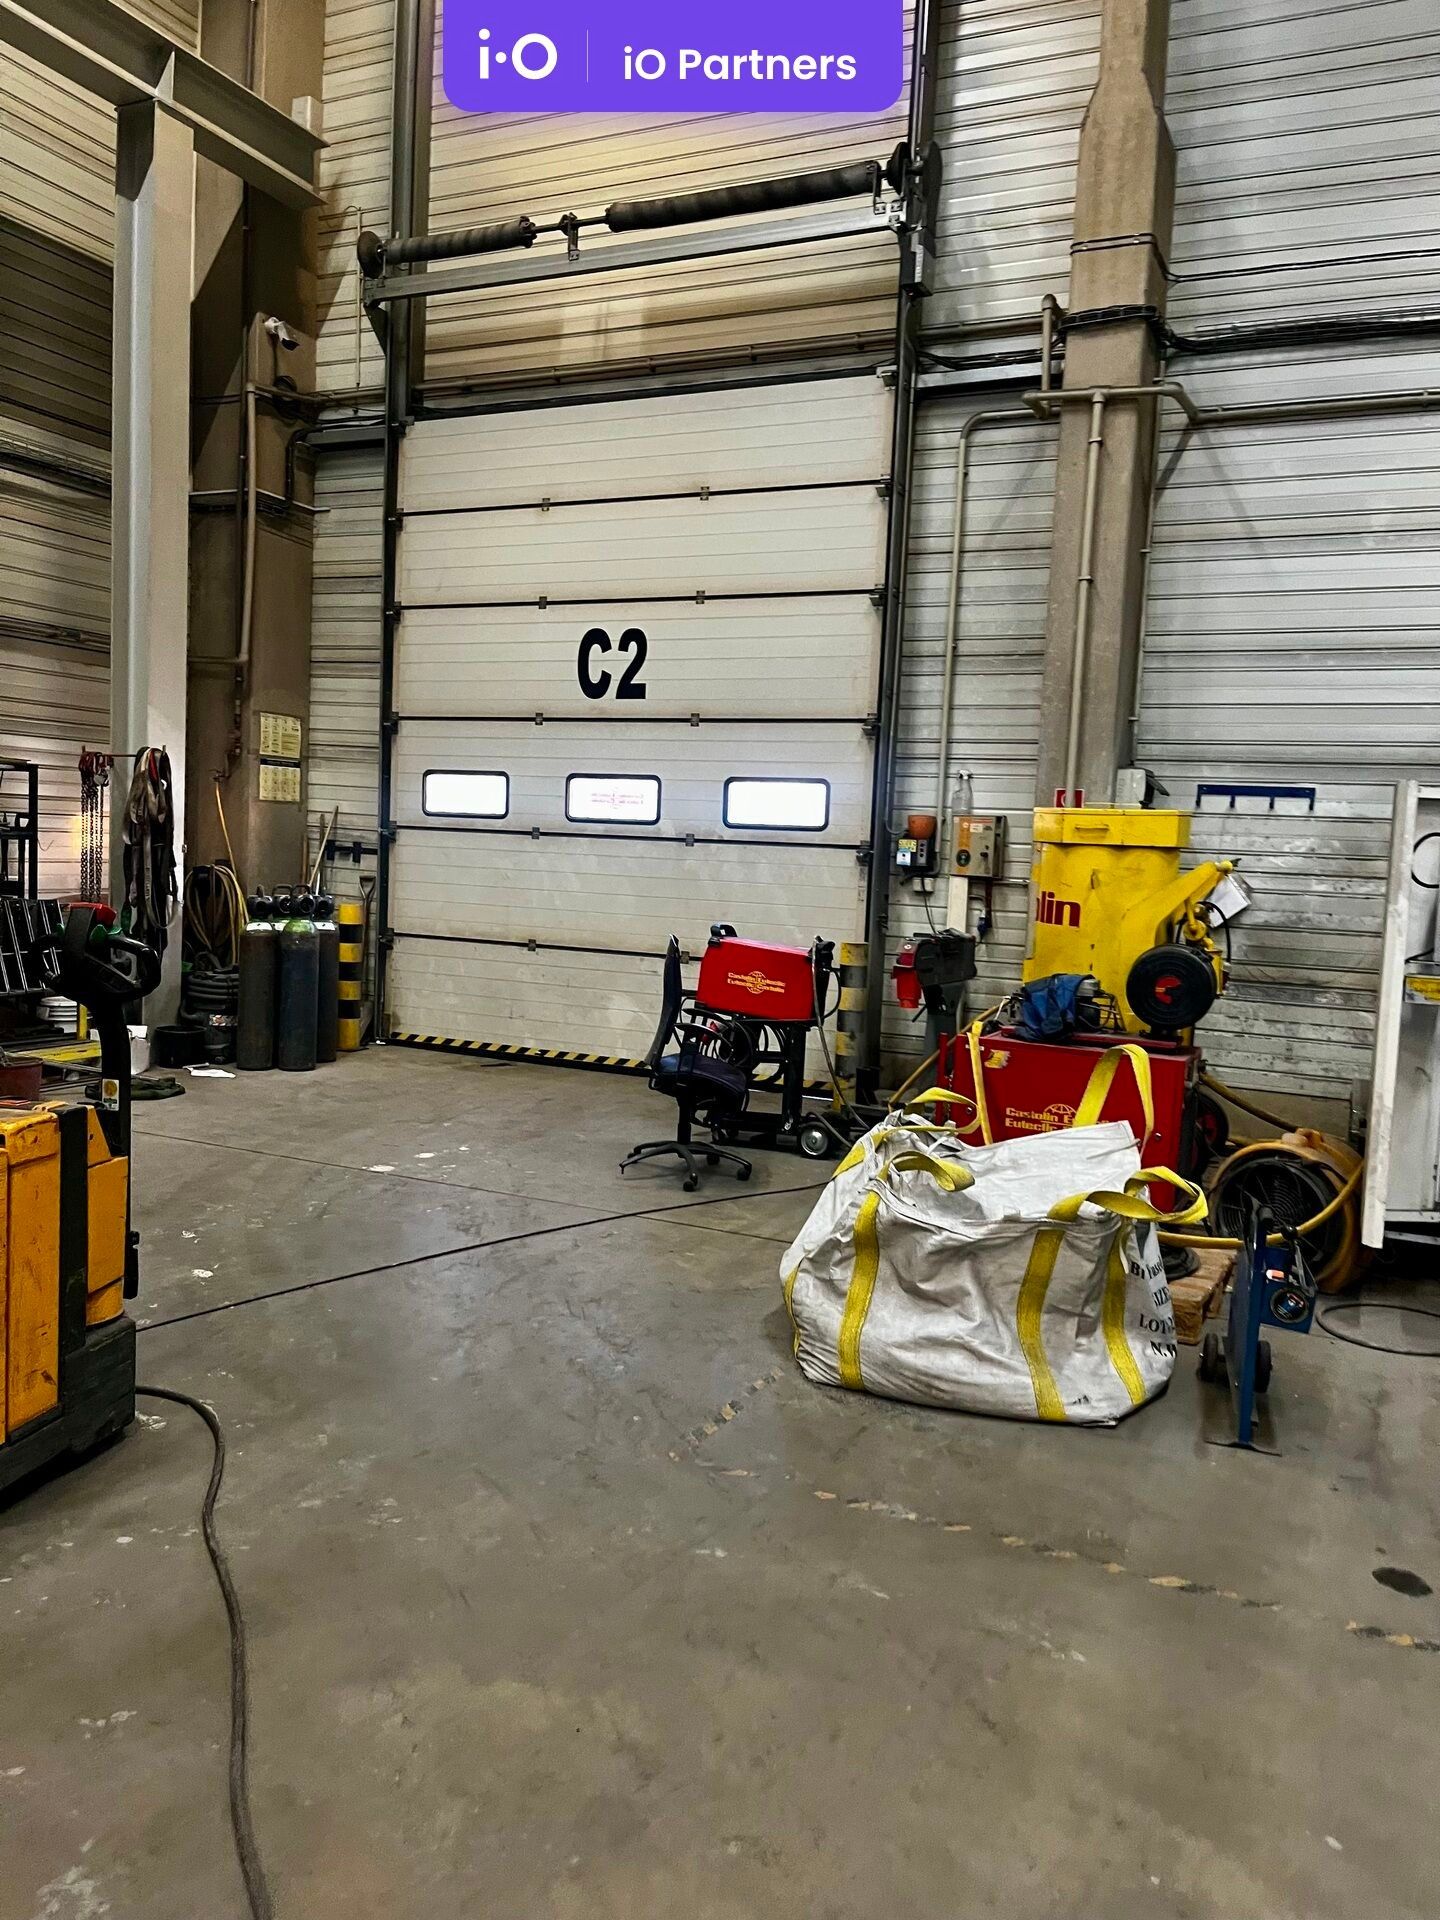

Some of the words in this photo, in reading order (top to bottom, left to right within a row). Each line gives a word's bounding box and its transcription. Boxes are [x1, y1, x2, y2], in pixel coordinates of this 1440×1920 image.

[577, 627, 648, 700] C2
[1036, 890, 1081, 928] lin
[1005, 1107, 1059, 1122] Castolin
